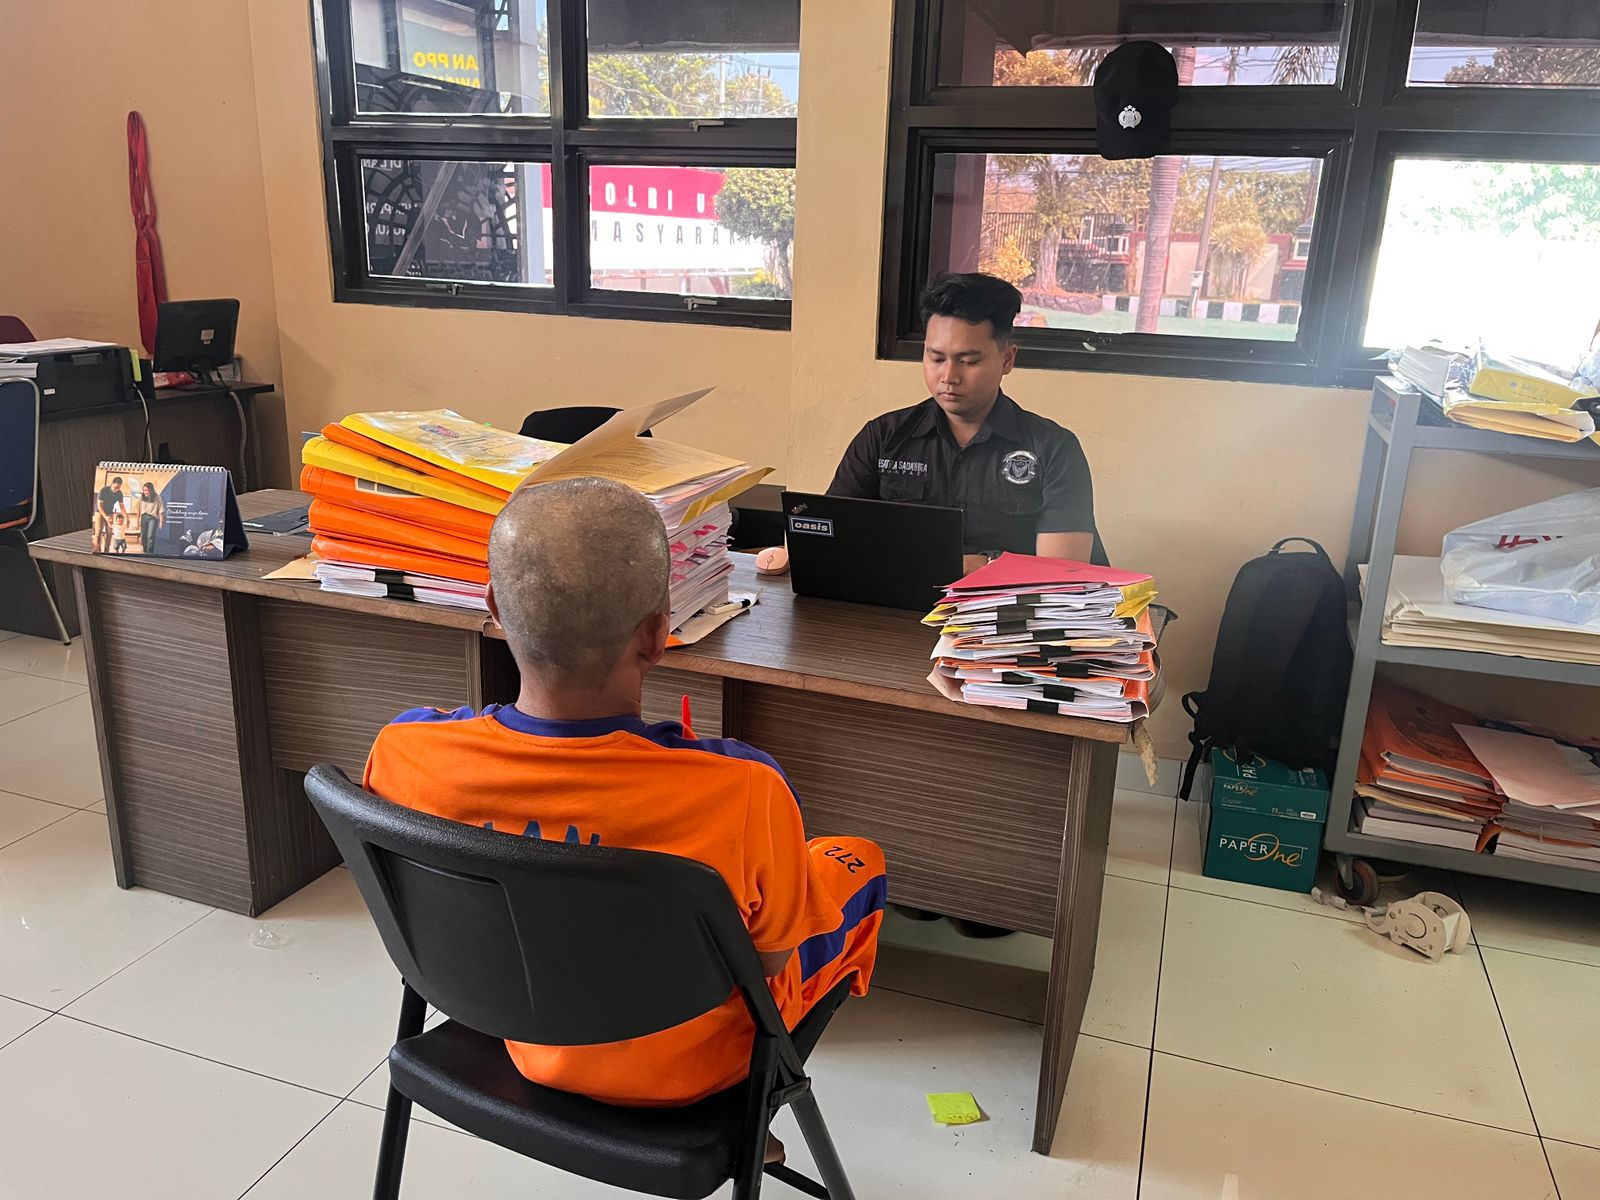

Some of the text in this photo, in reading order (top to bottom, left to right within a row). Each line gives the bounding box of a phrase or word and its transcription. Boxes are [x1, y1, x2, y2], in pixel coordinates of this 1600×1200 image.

[794, 522, 829, 532] oasis
[1219, 838, 1268, 855] PAPER
[824, 846, 866, 873] 272
